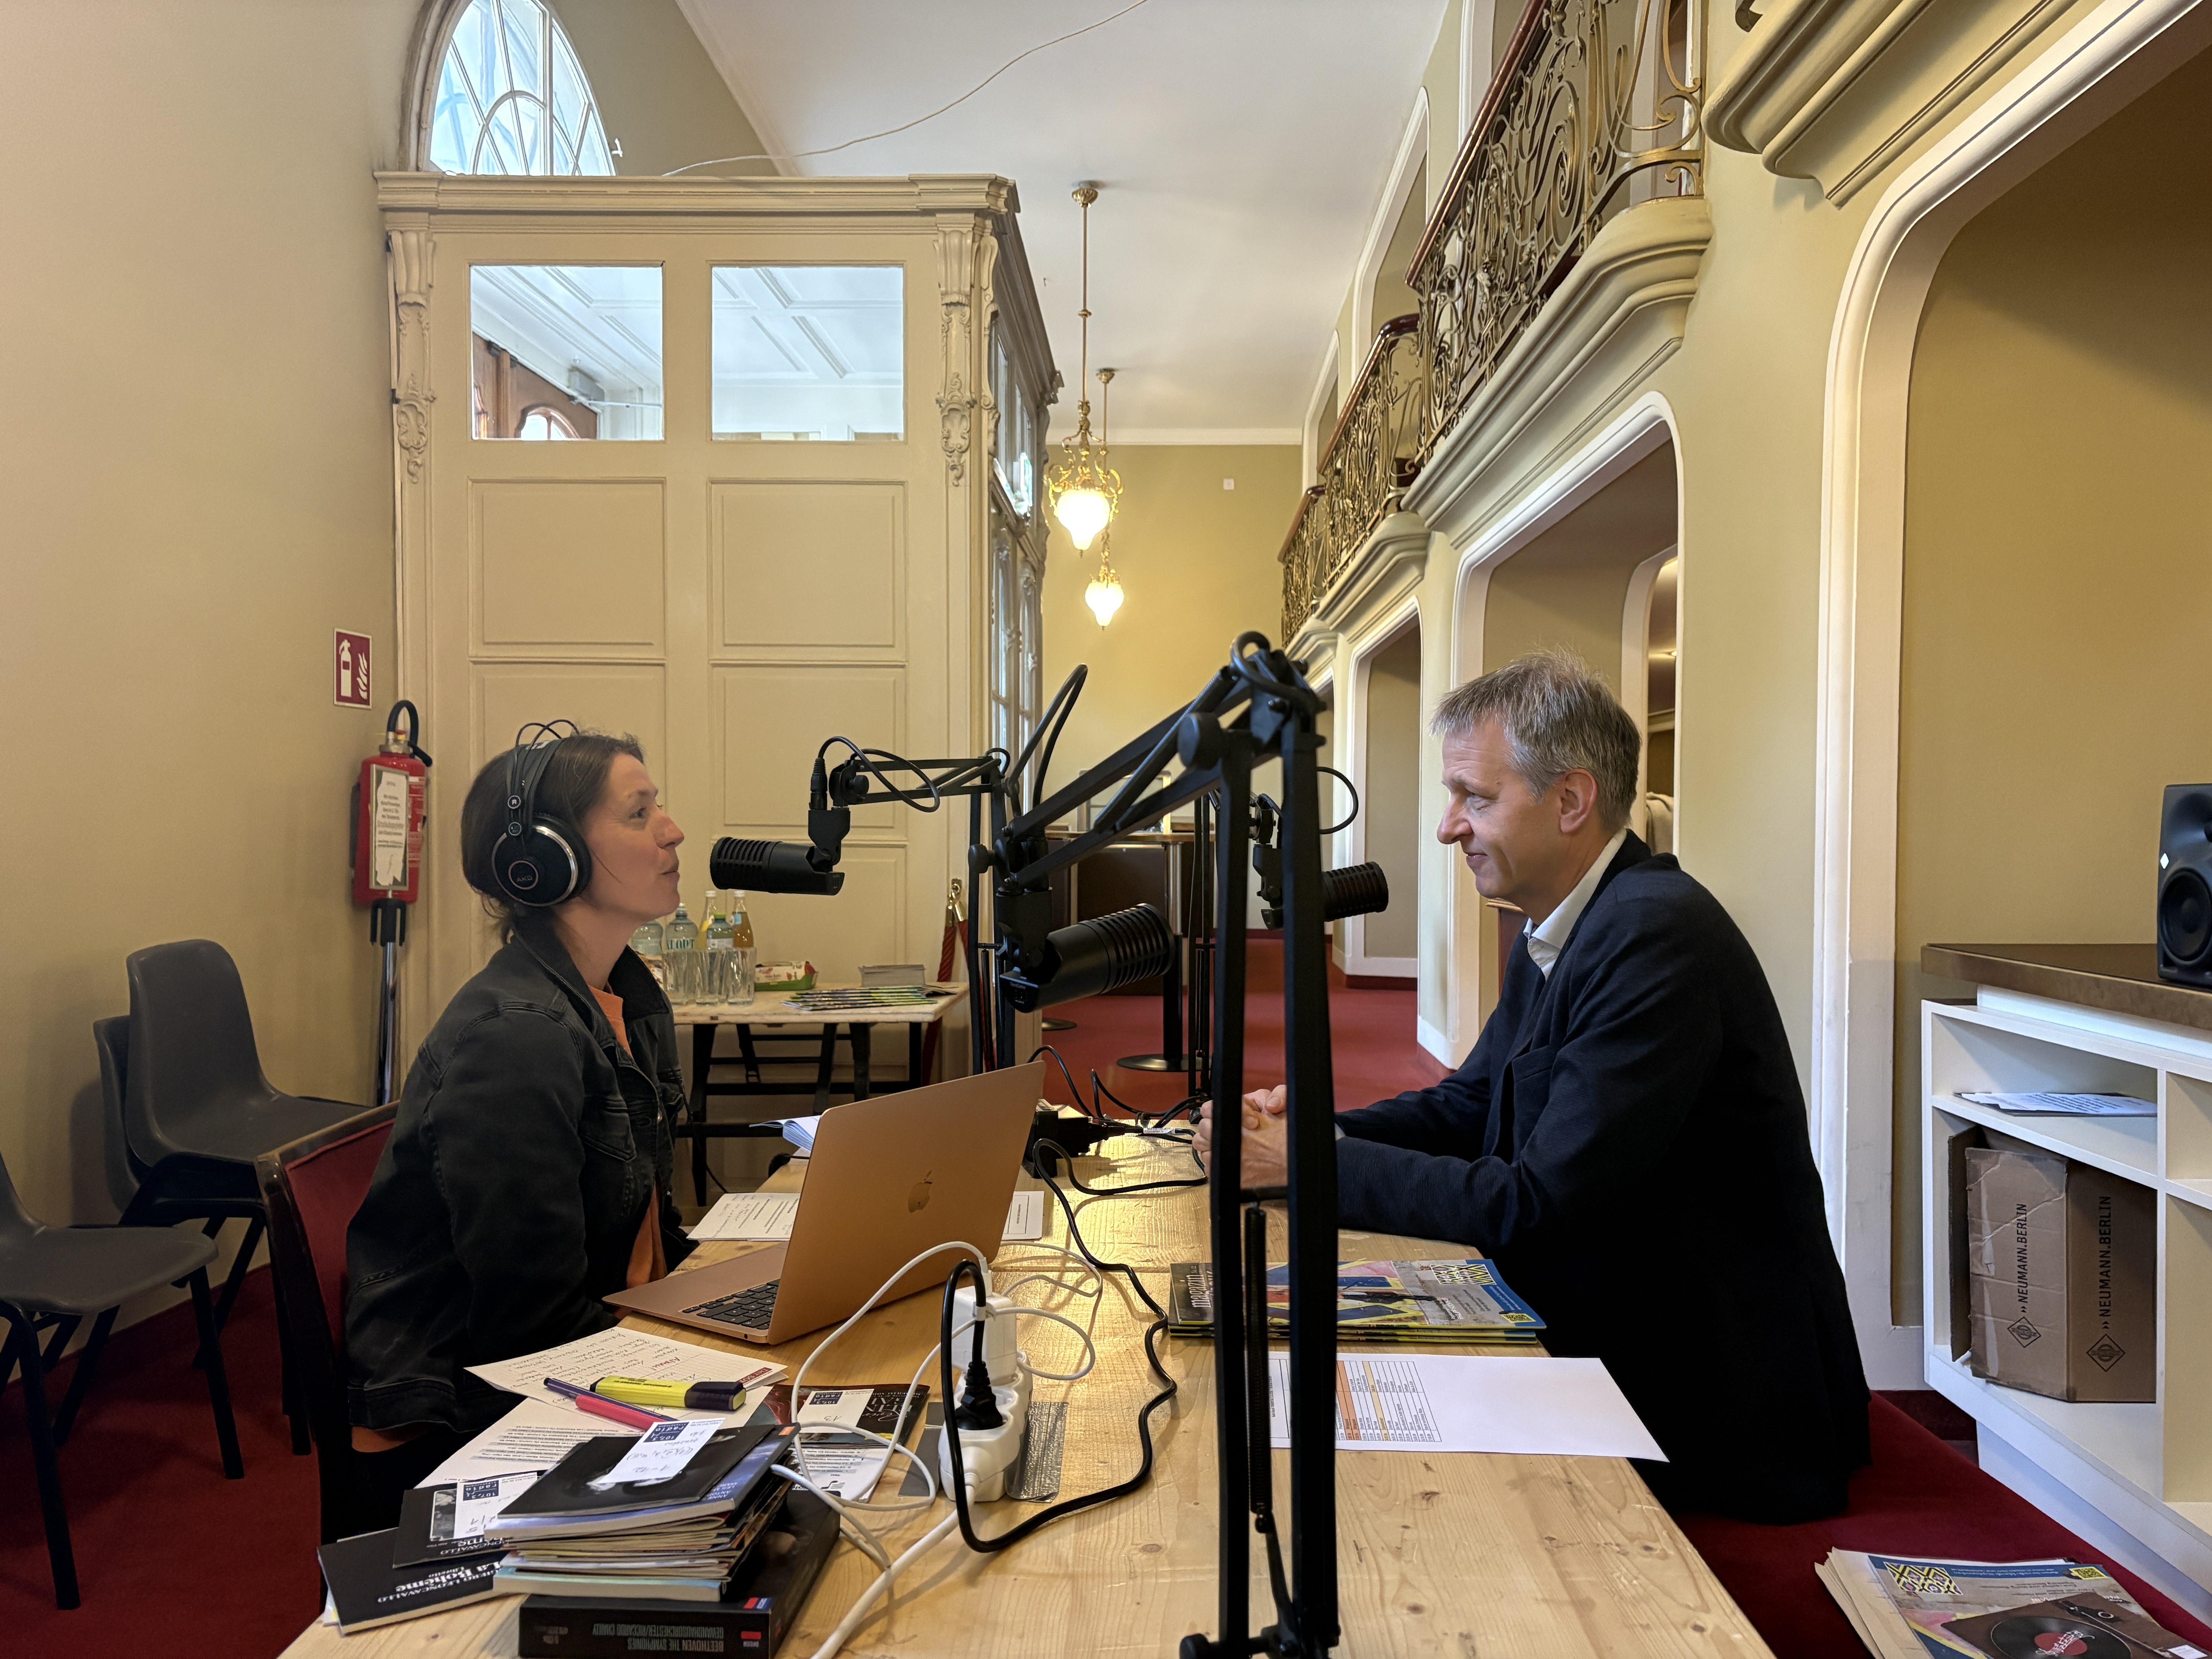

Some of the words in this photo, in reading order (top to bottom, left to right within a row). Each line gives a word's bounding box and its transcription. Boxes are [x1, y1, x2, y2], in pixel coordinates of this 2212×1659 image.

[2016, 1204, 2028, 1303] NEUMANN.BERLIN
[2099, 1196, 2111, 1317] NEUMANN.BERLIN
[1180, 1274, 1212, 1308] magazin
[440, 1540, 509, 1555] ONCAVALLO
[476, 1561, 500, 1572] La
[378, 1579, 460, 1602] LEONCAVALLO
[668, 1638, 680, 1651] THE
[682, 1639, 724, 1652] BEETHOVEN
